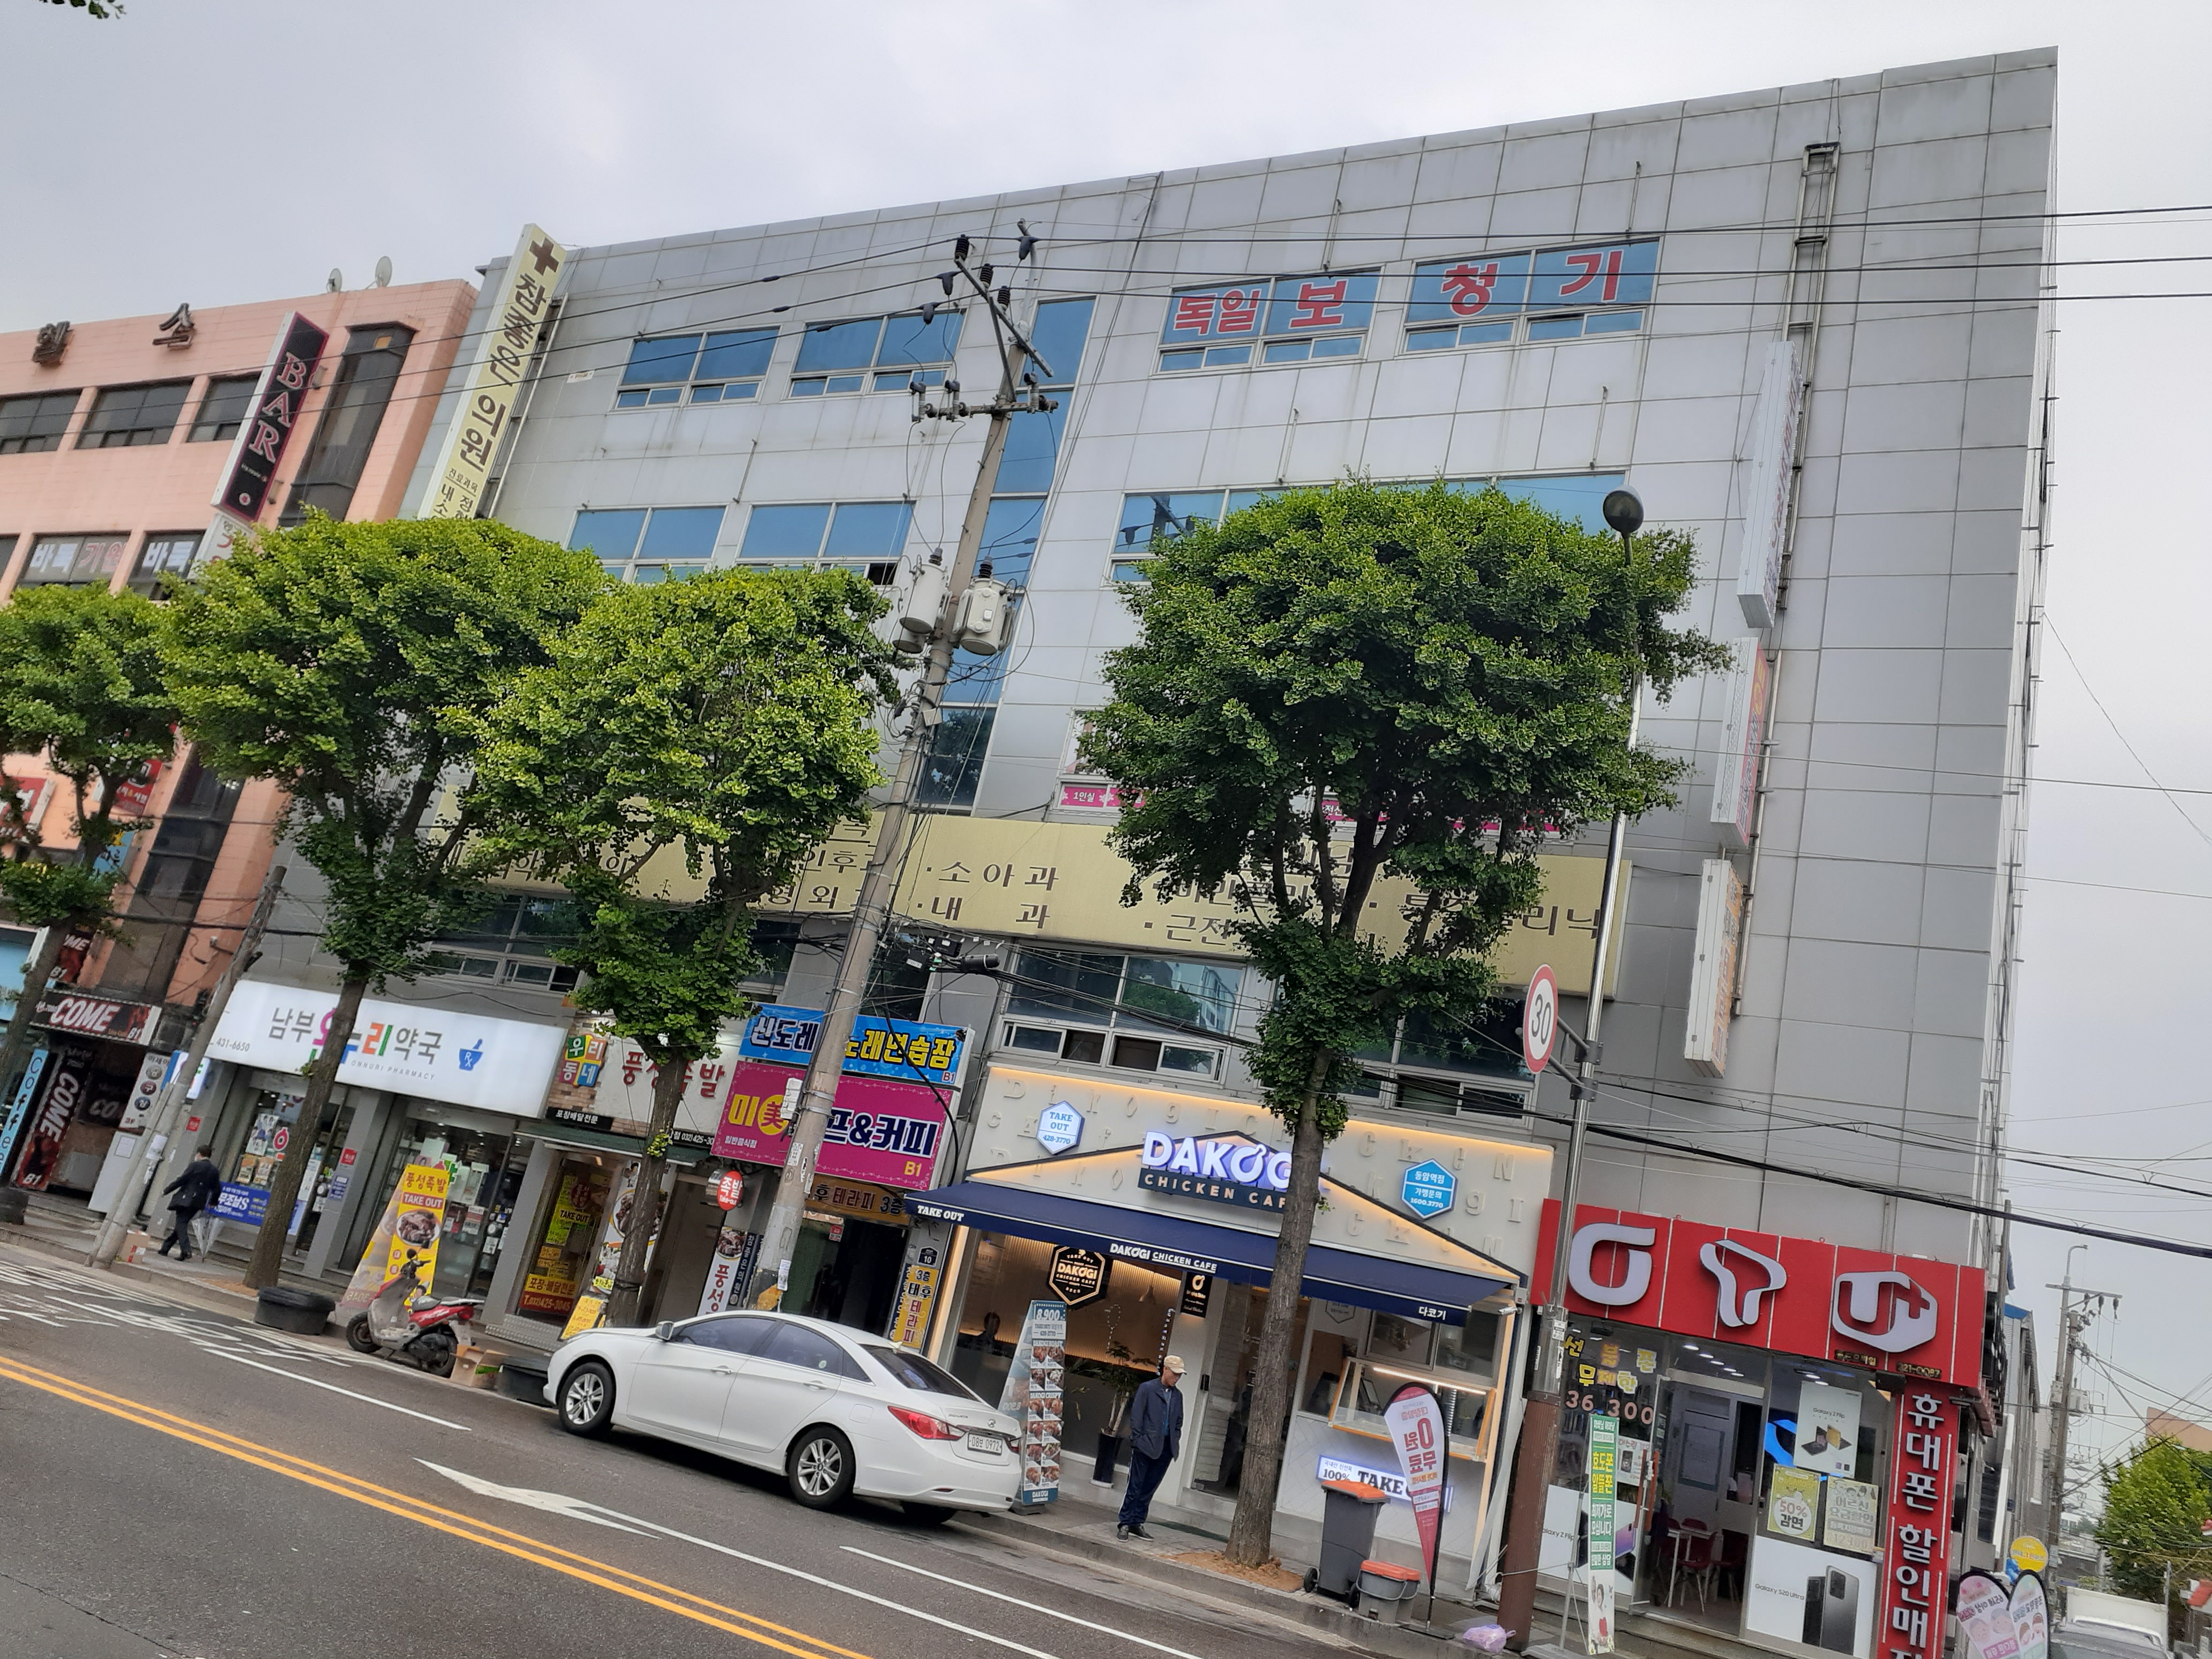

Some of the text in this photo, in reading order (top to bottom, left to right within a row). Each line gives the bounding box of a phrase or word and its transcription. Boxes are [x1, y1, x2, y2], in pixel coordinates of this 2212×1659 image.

[1175, 289, 1259, 335] 독일
[460, 273, 547, 473] 참좋은 의원
[248, 352, 307, 463] BAR
[449, 468, 478, 493] 진료과목
[29, 542, 78, 574] 바둑
[141, 541, 195, 573] 바둑
[1073, 791, 1095, 803] 1인실
[938, 861, 1059, 891] 소아과
[50, 966, 68, 979] B1
[50, 998, 121, 1032] COME
[128, 1027, 143, 1040] B1
[1531, 994, 1552, 1041] 30
[215, 1038, 250, 1053] 431-6650
[567, 1037, 606, 1060] 우리
[350, 1060, 436, 1081] ONNURI PHARMACY
[560, 1060, 597, 1084] 동네
[941, 1071, 955, 1083] B1
[0, 1057, 42, 1162] Coffe
[39, 1072, 79, 1142] COME
[556, 1109, 599, 1124] 포장배달전문
[1049, 1111, 1073, 1122] TAKE
[1050, 1120, 1070, 1132] OUT
[724, 1135, 757, 1148] 일반음식점
[1042, 1134, 1071, 1145] 428-3770
[904, 1161, 922, 1177] B1
[1414, 1170, 1445, 1185] 동암역점
[22, 1173, 42, 1185] B1
[405, 1172, 447, 1193] 풍성족발
[721, 1176, 743, 1199] 족발
[1144, 1174, 1234, 1199] CHICKEN
[404, 1194, 443, 1207] TAKE OUT
[832, 1185, 875, 1211] 테라피
[1414, 1187, 1443, 1200] 가맹문의
[560, 1209, 589, 1223] TAKE OUT
[916, 1205, 965, 1222] TAKE OUT
[924, 1255, 932, 1264] 10
[1109, 1243, 1217, 1272] DAKOGI CHICKEN CAFE
[916, 1269, 931, 1282] 3층
[1056, 1273, 1080, 1282] CHICKEN
[1057, 1262, 1098, 1280] DAKOGI
[706, 1264, 730, 1314] 풍성
[907, 1281, 933, 1299] 태후
[902, 1299, 923, 1343] 테라피
[1418, 1305, 1446, 1321] 다코기
[1813, 1407, 1831, 1417] Galaxy
[985, 1439, 999, 1452] 0972
[1901, 1393, 1945, 1511] 휴대폰
[1324, 1459, 1337, 1469] 국내산
[1593, 1451, 1614, 1473] 효도폰
[1322, 1467, 1350, 1482] 100%
[1357, 1470, 1403, 1494] TAKE
[1591, 1473, 1613, 1494] 알뜰폰
[1591, 1503, 1613, 1519] 최저가로
[1780, 1500, 1807, 1518] 50%
[1835, 1496, 1869, 1513] 어르신
[1591, 1521, 1612, 1536] 모십니다
[1780, 1514, 1803, 1531] 감면
[1602, 1554, 1611, 1566] 상담
[1755, 1582, 1805, 1601] Galaxy S20 Ultra
